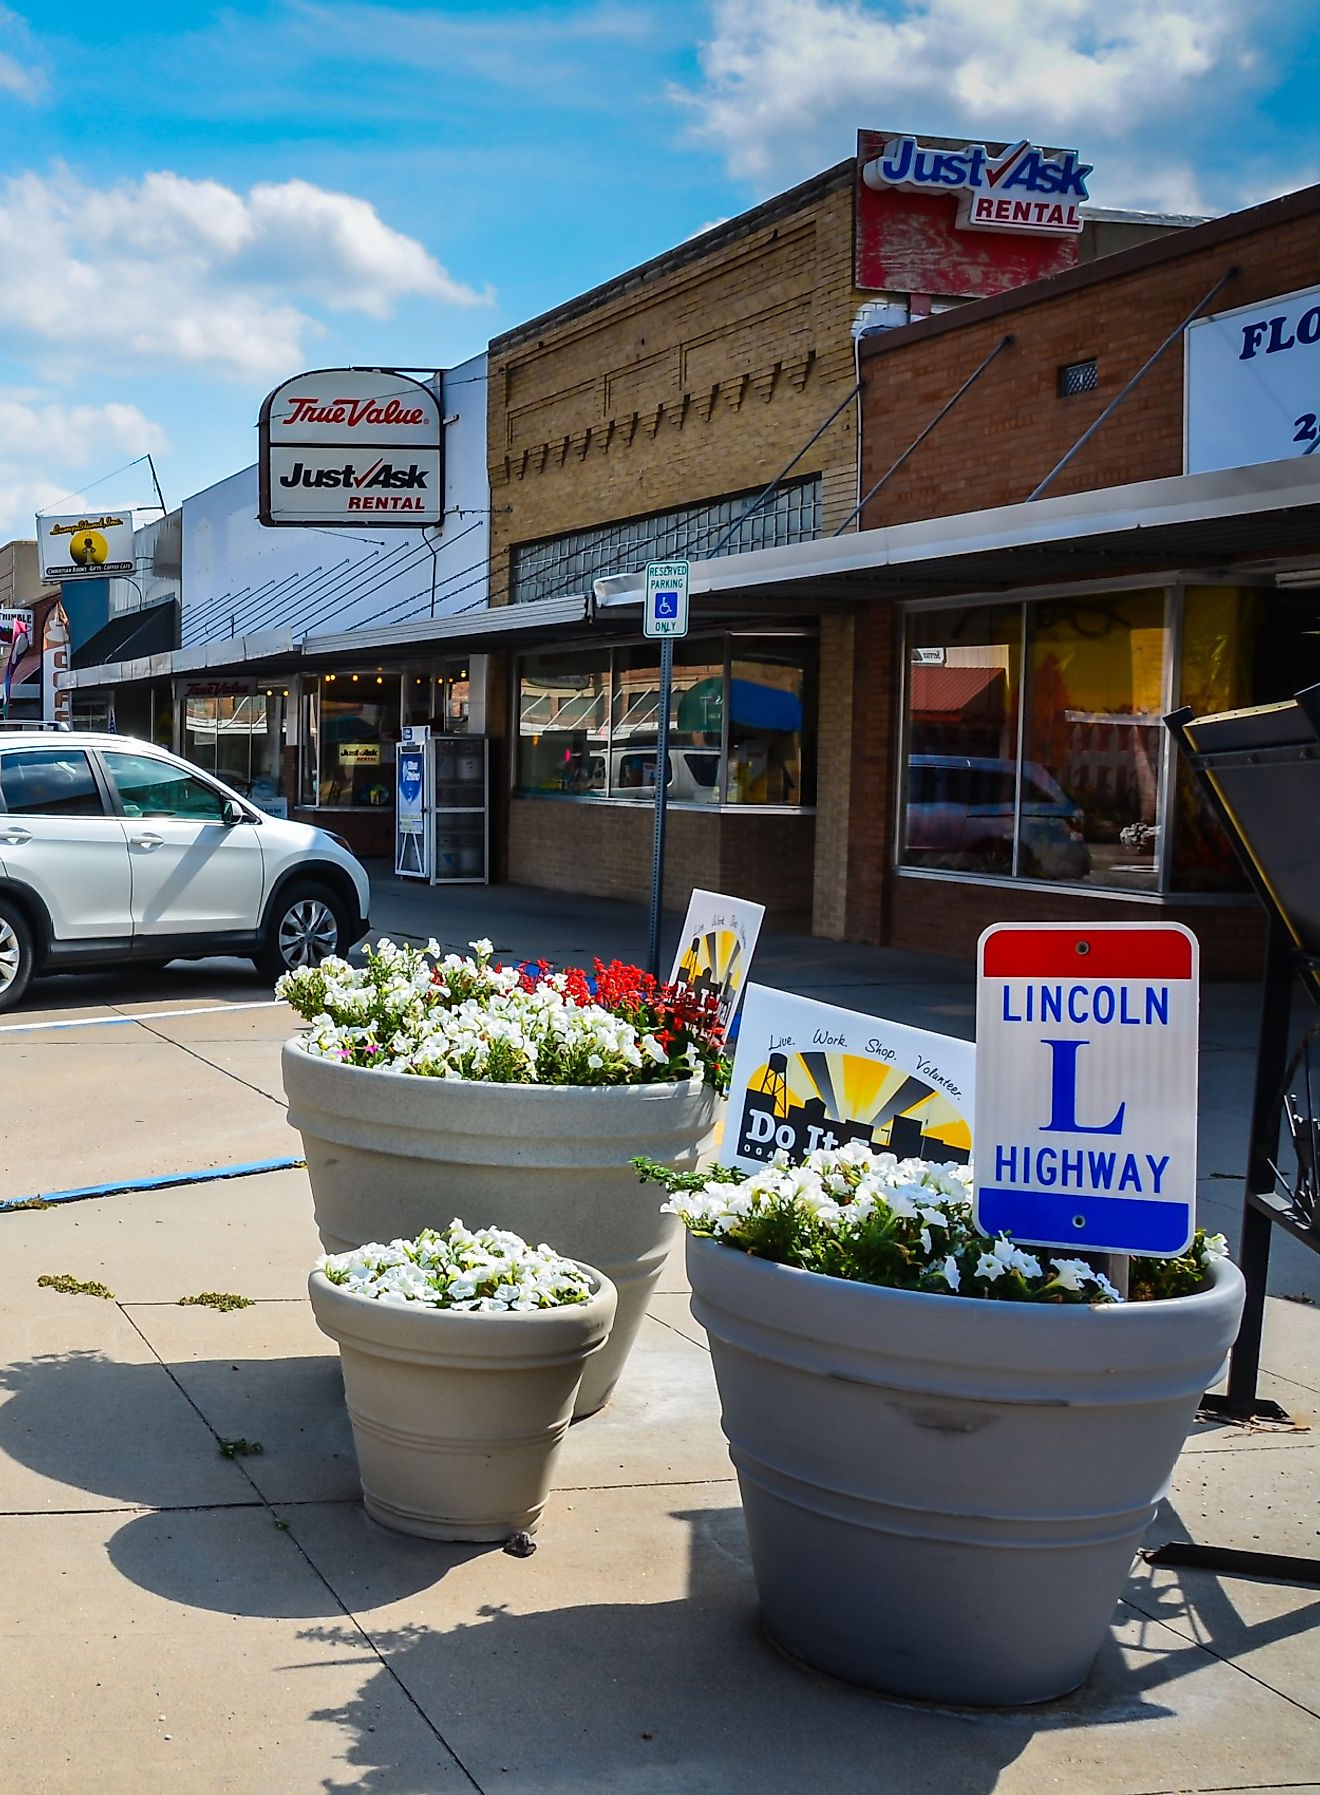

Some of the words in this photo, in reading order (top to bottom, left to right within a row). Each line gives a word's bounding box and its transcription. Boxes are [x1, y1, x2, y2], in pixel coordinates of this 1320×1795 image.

[883, 140, 987, 188] Just
[1002, 151, 1090, 197] Ask
[975, 197, 1081, 226] RENTAL
[280, 462, 356, 489] Just
[364, 463, 430, 490] Ask
[348, 496, 426, 510] RENTAL
[650, 565, 687, 577] RESERVED
[651, 578, 683, 589] PARKING
[655, 622, 676, 632] ONLY
[1002, 984, 1169, 1026] LINCOLN
[768, 1035, 796, 1051] Live.
[812, 1028, 848, 1048] Work.
[864, 1038, 897, 1062] Shop.
[916, 1054, 962, 1101] Volunteer.
[1038, 1039, 1126, 1136] L
[745, 1108, 797, 1150] Do
[802, 1124, 839, 1156] It
[995, 1145, 1170, 1194] HIGHWAY
